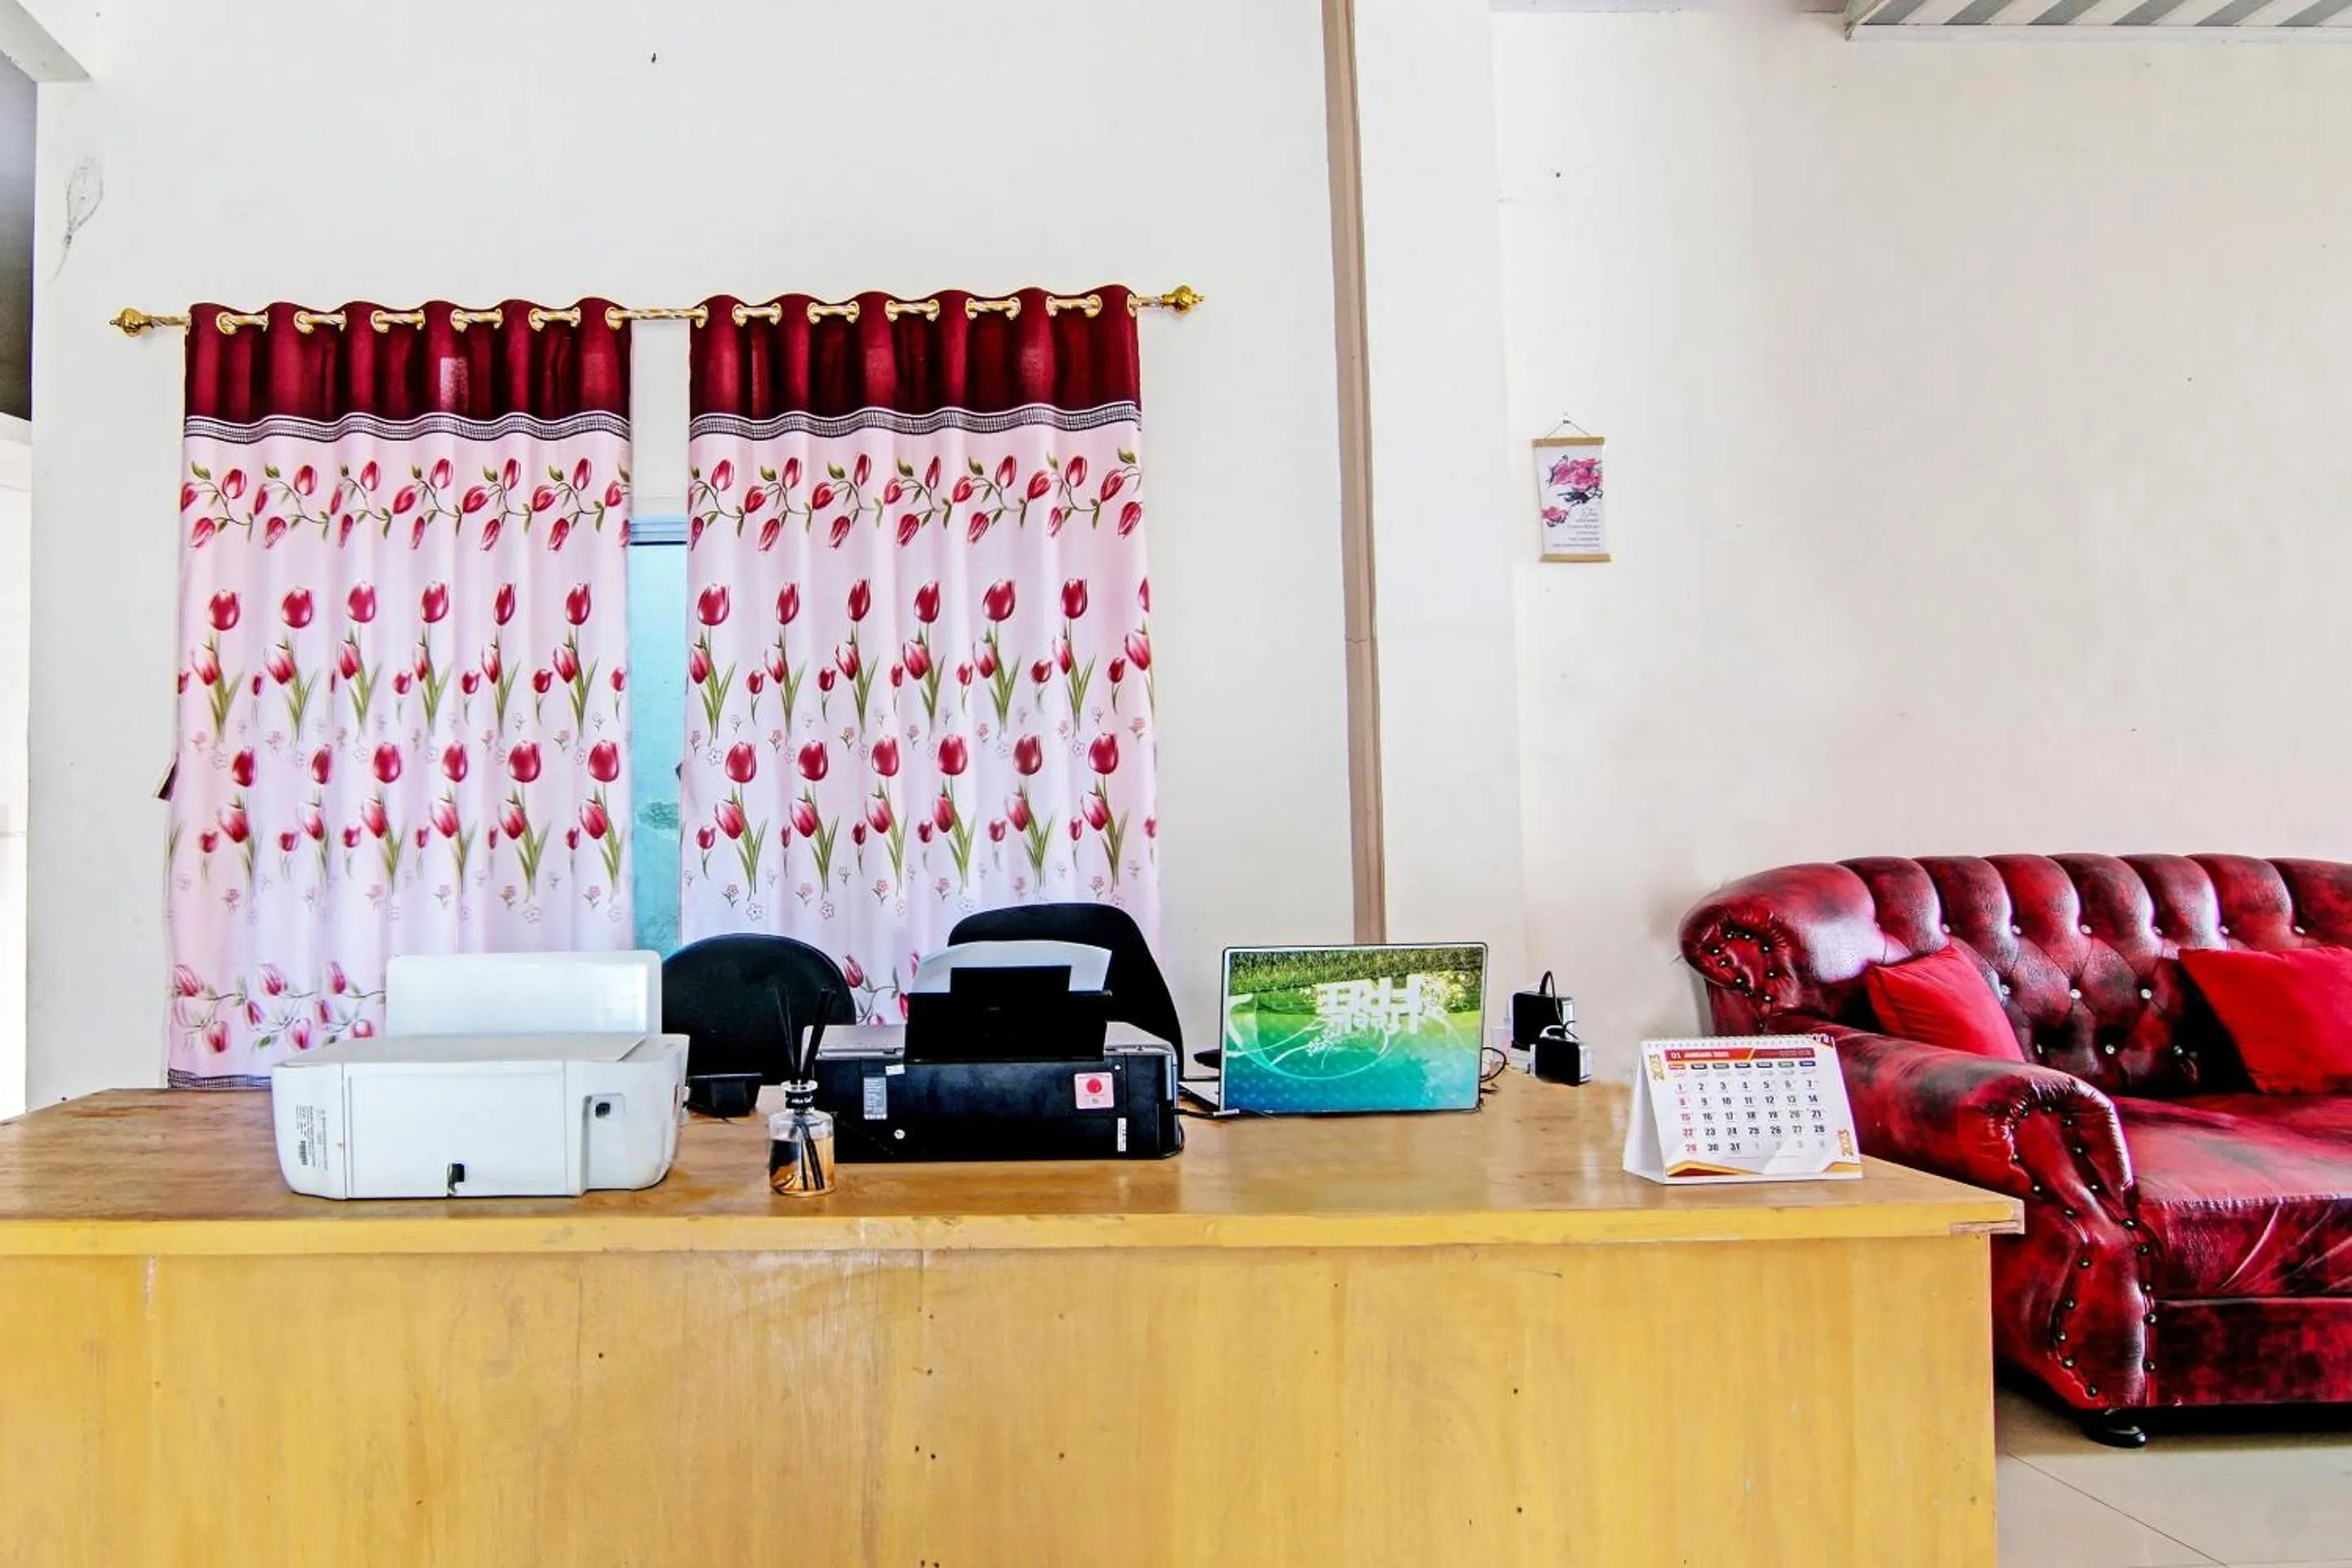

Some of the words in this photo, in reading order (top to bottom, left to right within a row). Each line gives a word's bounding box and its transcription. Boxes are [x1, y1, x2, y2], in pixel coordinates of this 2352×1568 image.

[1671, 1051, 1682, 1059] 01
[1720, 1081, 1726, 1090] 3
[1762, 1080, 1770, 1089] 5
[1701, 1097, 1708, 1106] 9
[1722, 1097, 1732, 1105] 10
[1744, 1096, 1753, 1105] 11
[1765, 1095, 1775, 1104] 12
[1786, 1095, 1796, 1103] 13
[1808, 1094, 1818, 1102] 14
[1681, 1112, 1691, 1121] 15
[1703, 1112, 1713, 1120] 16
[1725, 1111, 1733, 1120] 17
[1746, 1111, 1756, 1119] 18
[1811, 1110, 1822, 1118] 21
[1682, 1128, 1693, 1136] 22
[1705, 1127, 1716, 1136] 23
[1748, 1126, 1760, 1134] 25
[1770, 1125, 1781, 1134] 26
[1707, 1143, 1718, 1152] 30
[1730, 1143, 1740, 1152] 31
